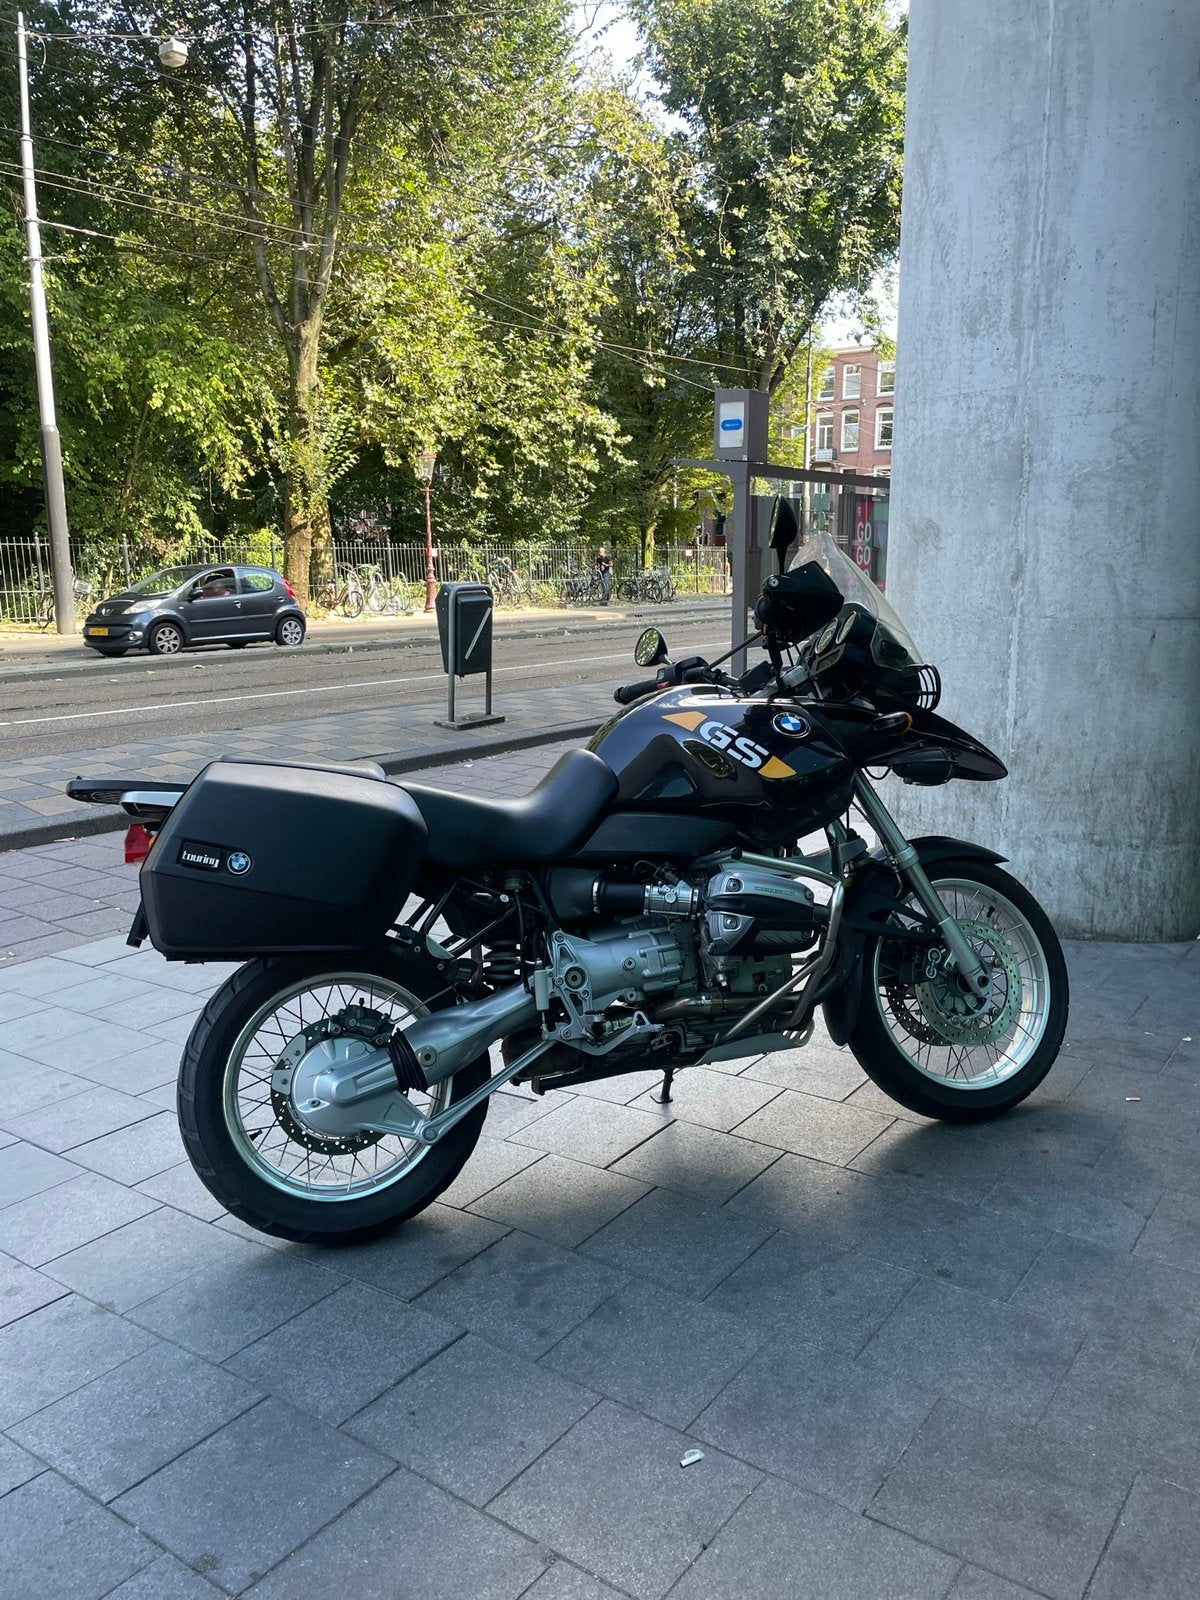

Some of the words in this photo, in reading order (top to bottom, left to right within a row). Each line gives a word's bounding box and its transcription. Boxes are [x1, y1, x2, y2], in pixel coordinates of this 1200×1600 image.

[857, 521, 872, 543] GO
[856, 546, 871, 565] GO
[699, 721, 770, 768] GS
[182, 850, 220, 868] touring
